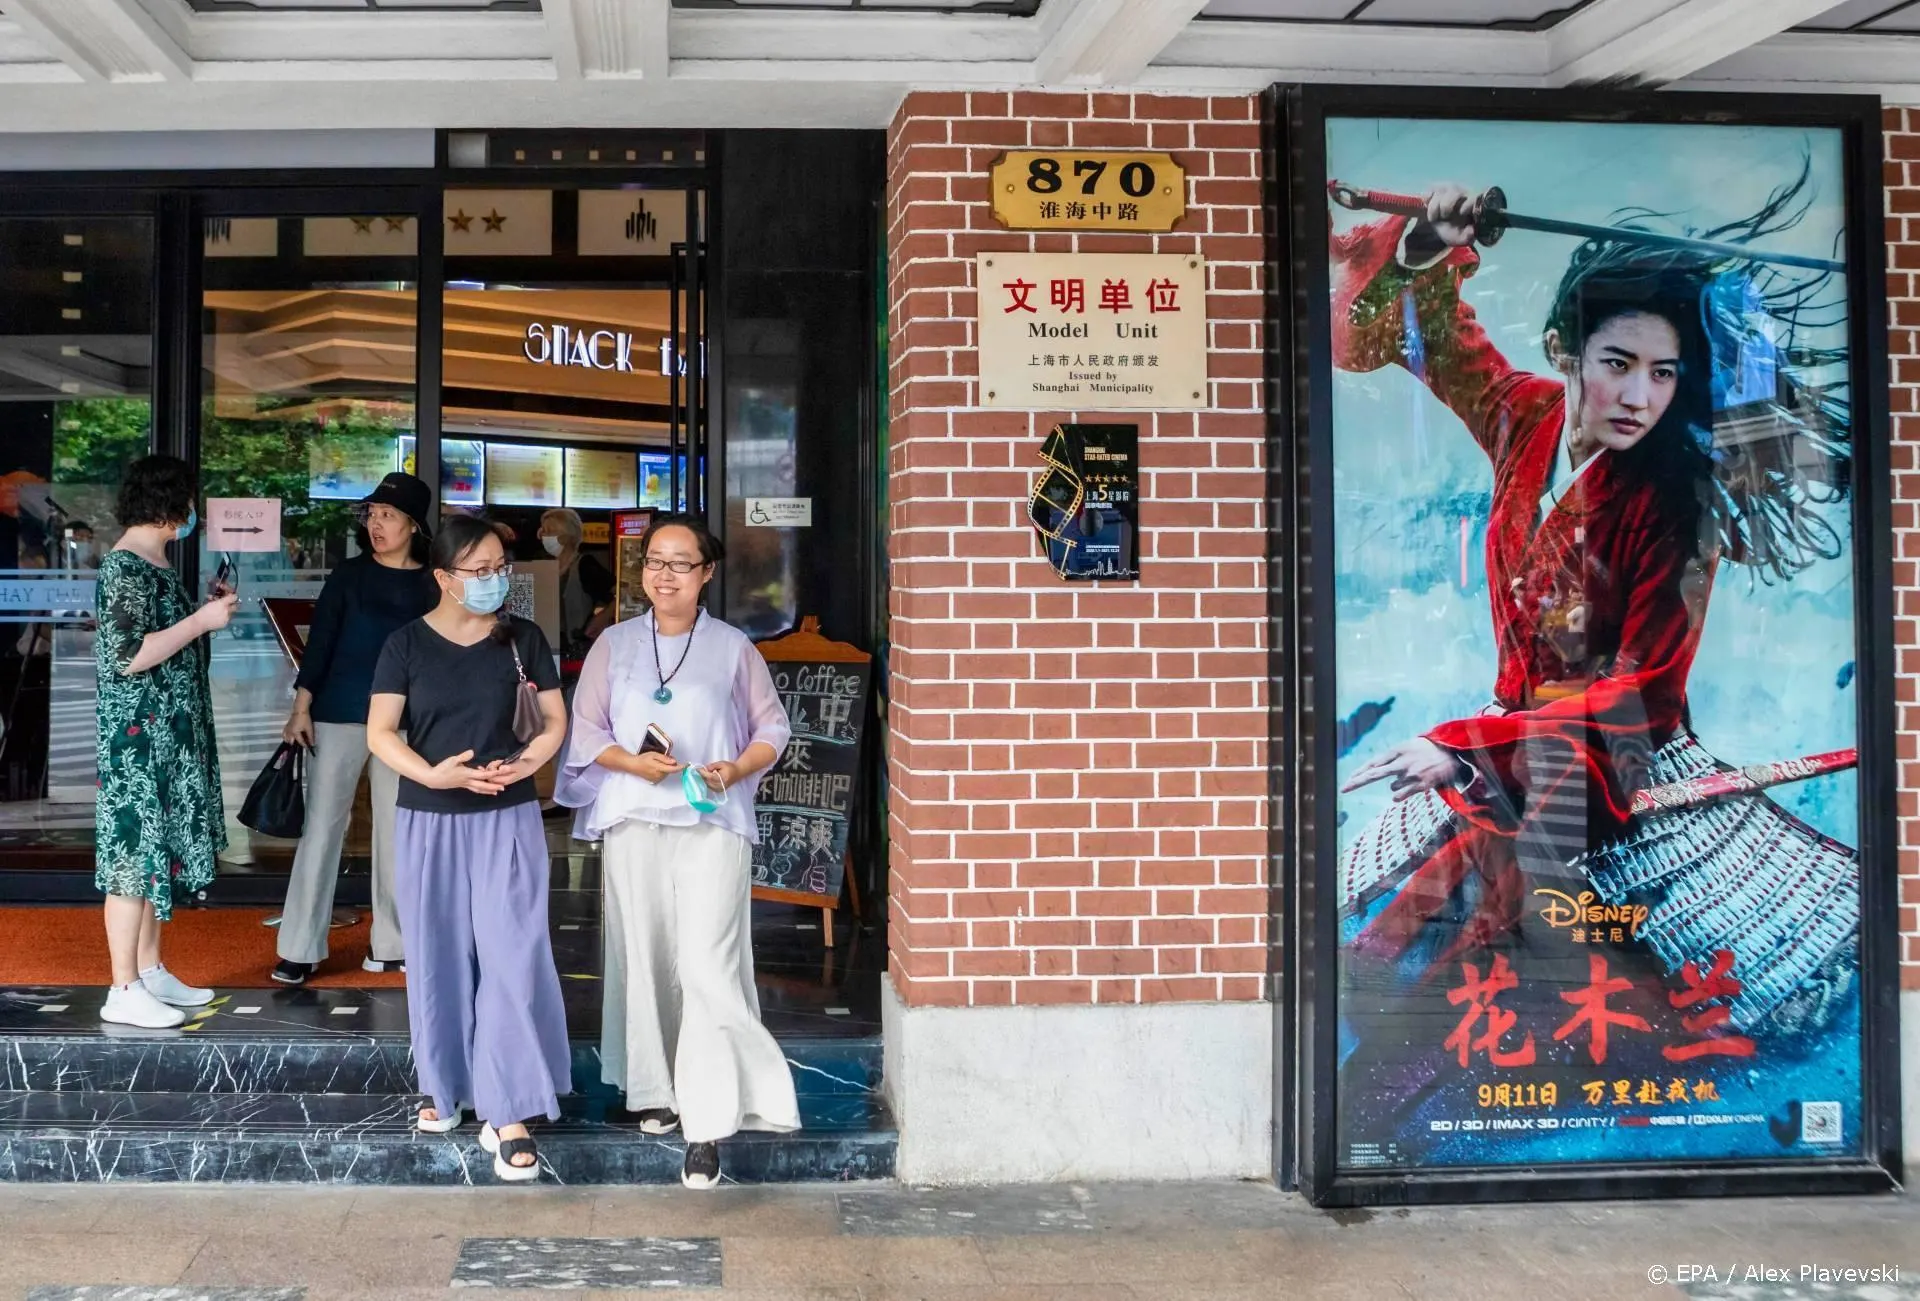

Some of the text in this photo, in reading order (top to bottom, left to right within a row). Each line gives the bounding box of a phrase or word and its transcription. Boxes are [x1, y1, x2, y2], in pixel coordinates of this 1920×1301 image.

[1026, 158, 1155, 198] 870
[1039, 200, 1140, 222] 淮海中路
[1002, 278, 1181, 314] 文明单位
[1028, 322, 1158, 338] Model Unit
[524, 322, 634, 373] SNACK
[1028, 354, 1160, 367] 上海市人民政府颁发
[1069, 371, 1117, 382] Issued by
[1032, 382, 1154, 394] Shanghai Municipality
[796, 664, 861, 694] Coffee
[1571, 927, 1624, 943] 迪士尼
[1443, 949, 1756, 1068] 花木兰
[1477, 1082, 1558, 1108] 9月11日
[1430, 1120, 1453, 1131] 2D
[1462, 1119, 1484, 1130] 3D
[1492, 1118, 1534, 1130] IMAX
[1537, 1117, 1560, 1129] 3D
